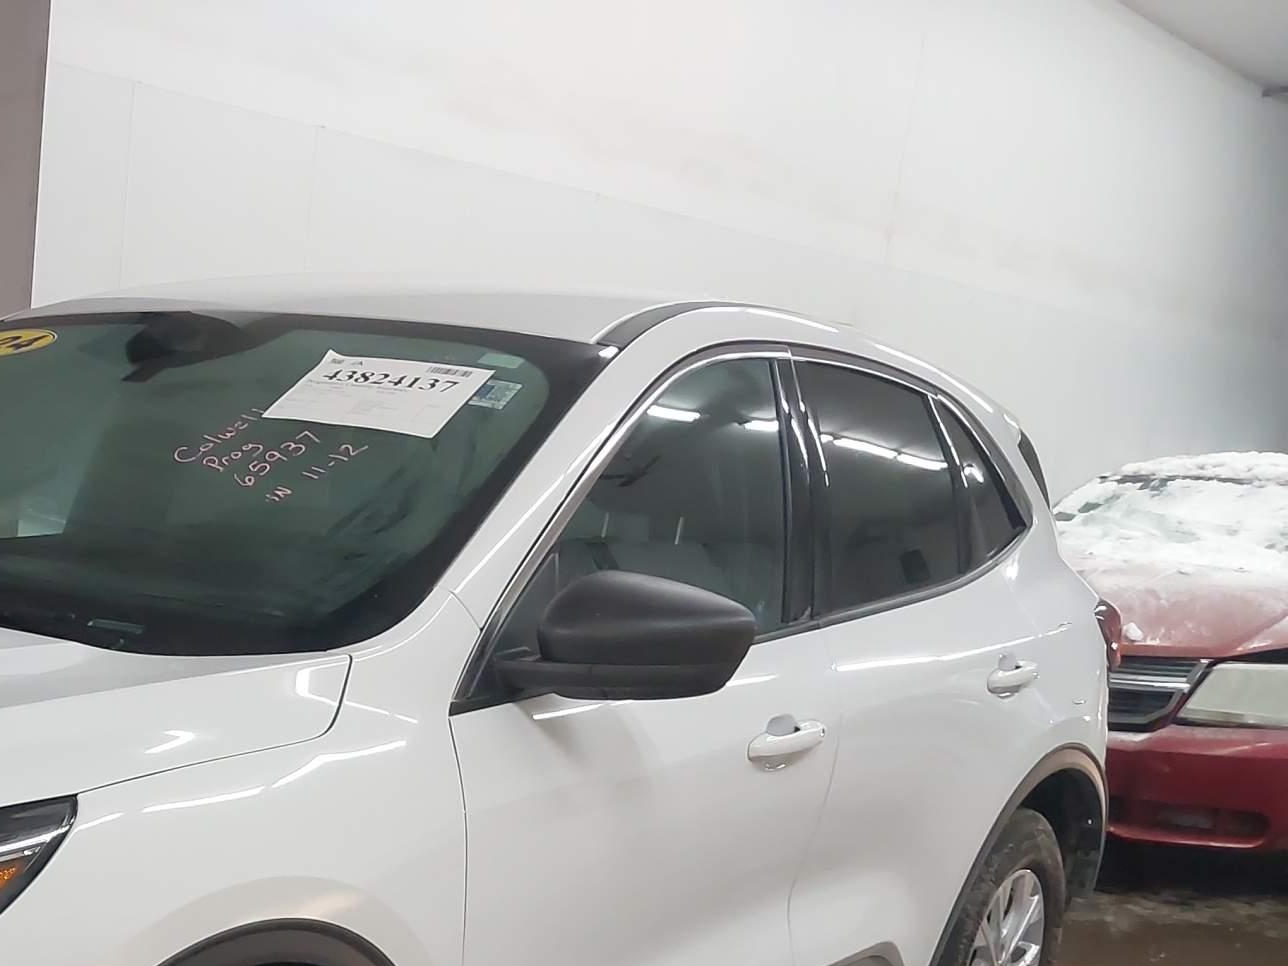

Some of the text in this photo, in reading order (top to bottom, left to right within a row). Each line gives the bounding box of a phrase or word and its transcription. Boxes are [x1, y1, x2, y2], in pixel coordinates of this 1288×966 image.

[323, 369, 459, 393] 43824137
[234, 430, 320, 487] 65937
[302, 444, 369, 479] 11-12
